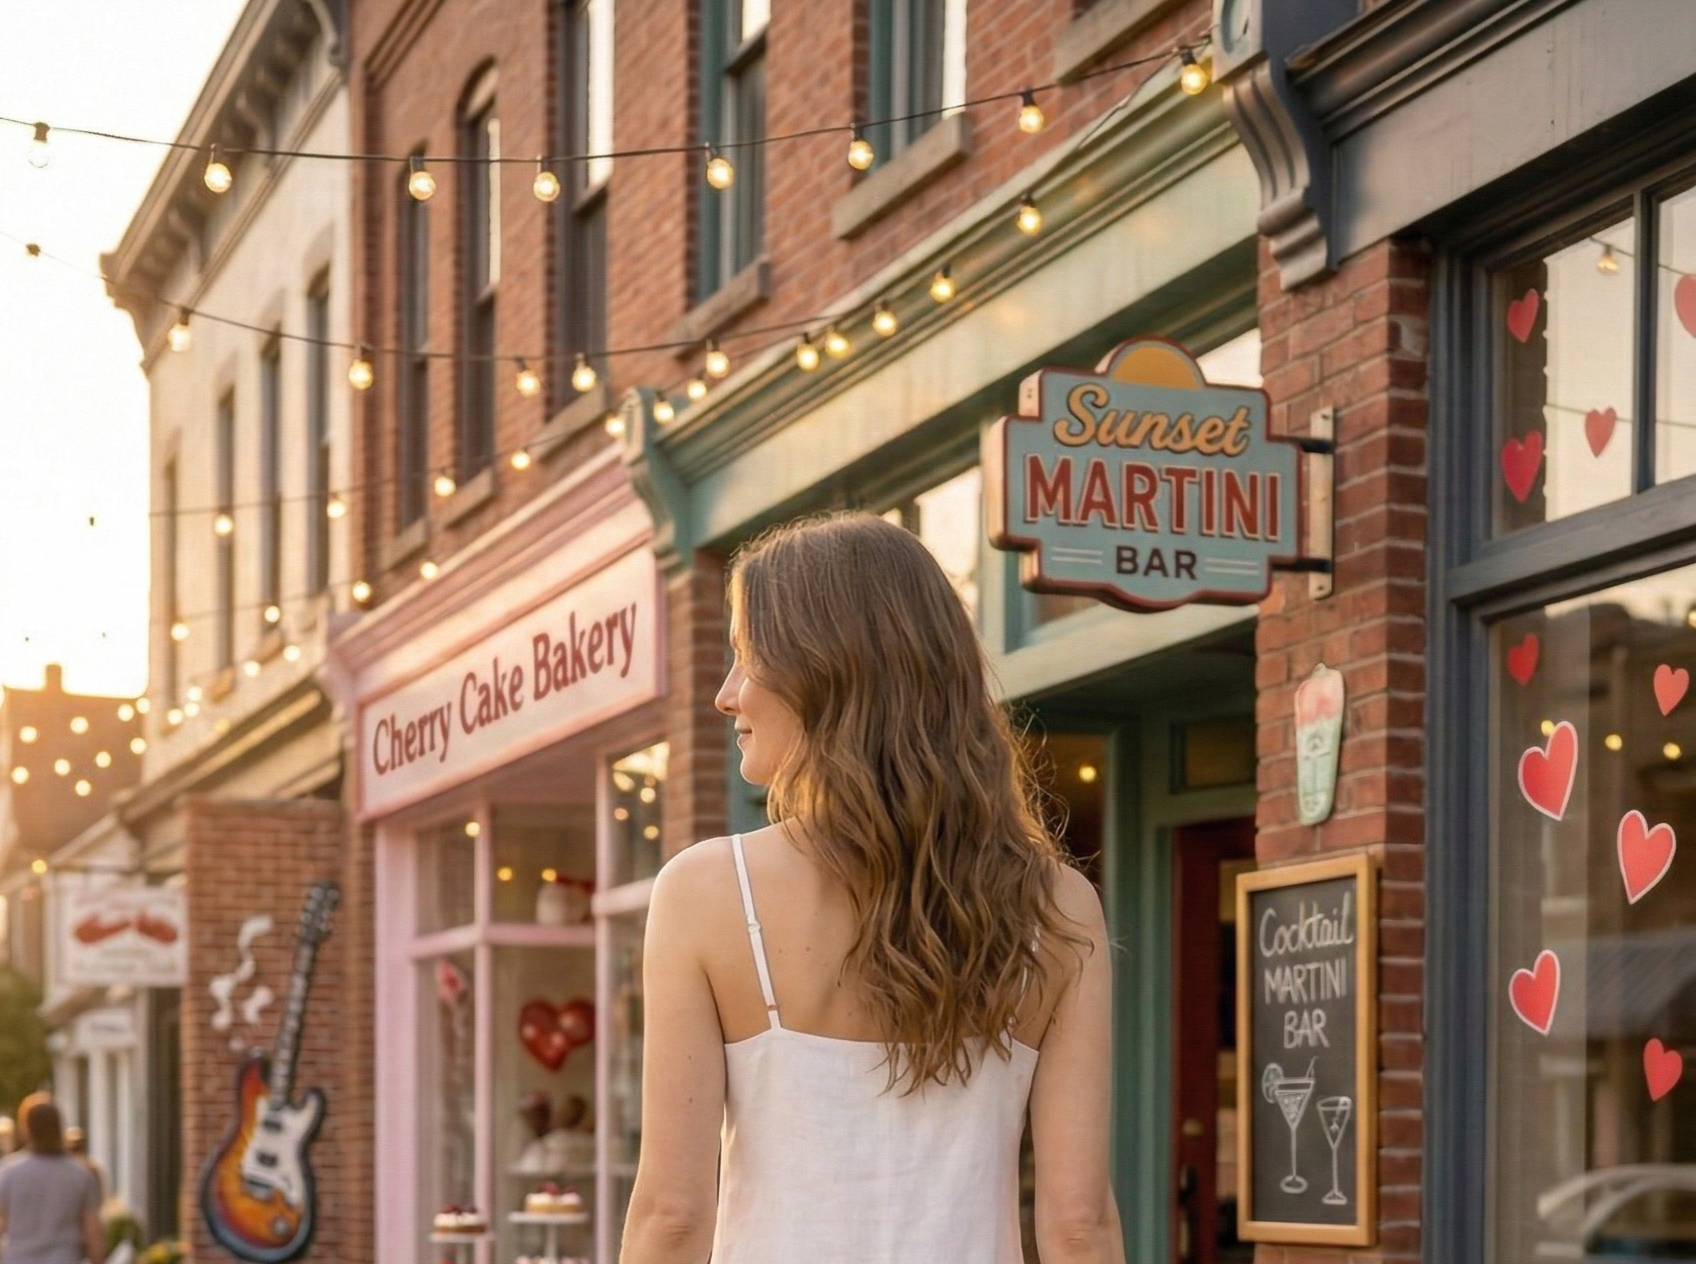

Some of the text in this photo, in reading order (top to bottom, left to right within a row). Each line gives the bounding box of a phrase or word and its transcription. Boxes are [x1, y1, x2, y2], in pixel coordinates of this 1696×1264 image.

[1053, 382, 1251, 457] Sunset
[1023, 453, 1282, 543] MARTINI
[1115, 545, 1198, 580] BAR
[373, 602, 637, 776] Cherry Cake Bakery
[1259, 891, 1354, 957] Cocktail
[1264, 957, 1347, 1005] MARTINI
[1283, 1008, 1330, 1049] BAR
